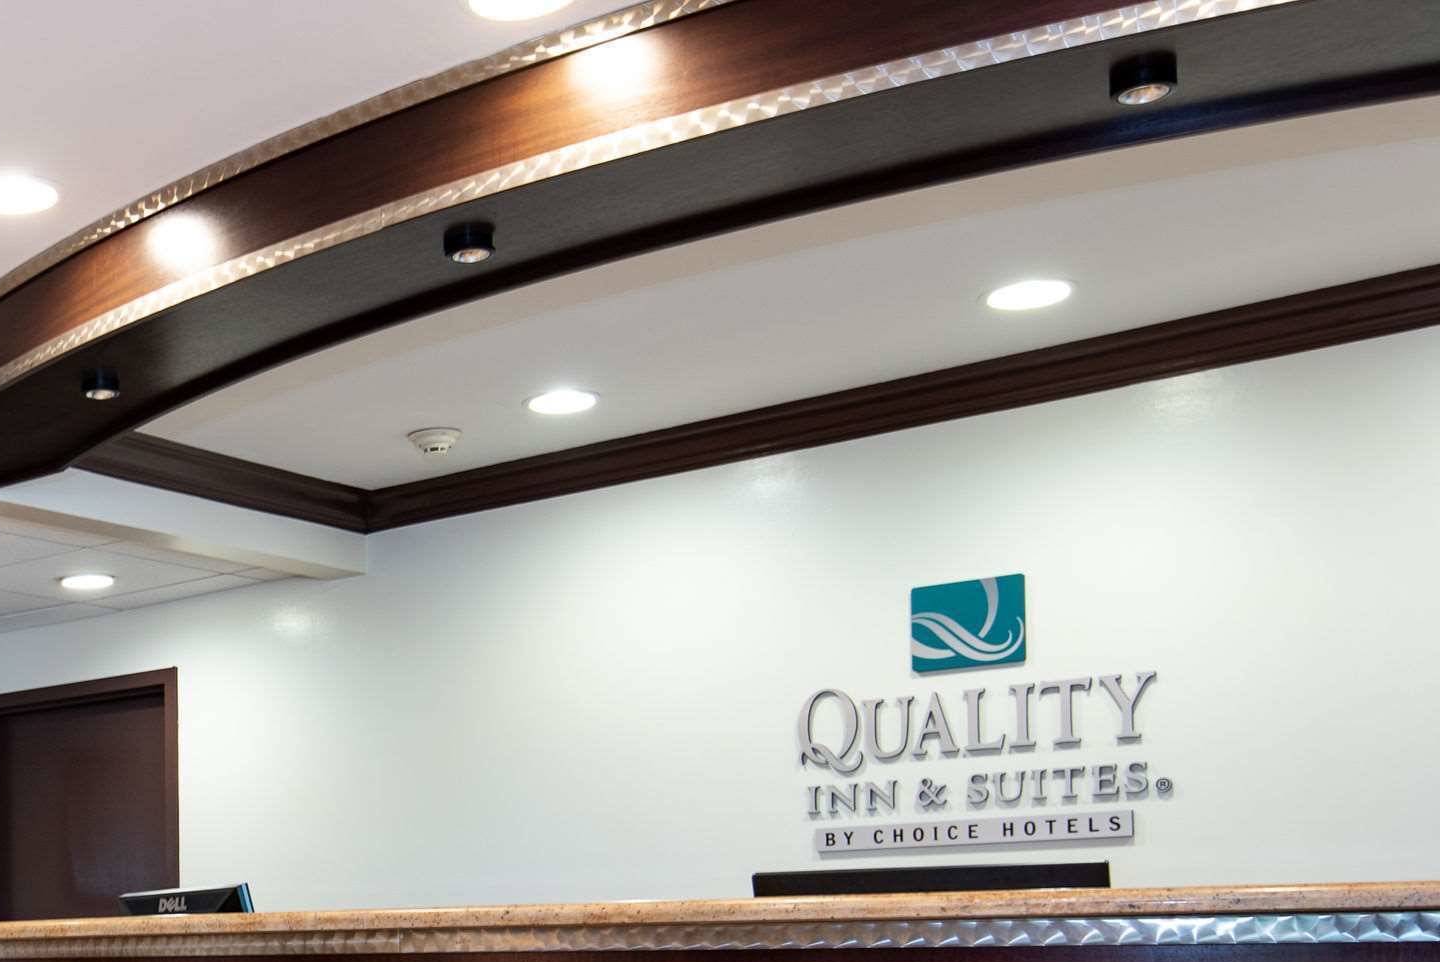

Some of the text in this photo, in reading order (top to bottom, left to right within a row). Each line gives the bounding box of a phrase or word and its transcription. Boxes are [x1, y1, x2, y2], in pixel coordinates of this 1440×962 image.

[798, 671, 1157, 775] QUALITY
[806, 779, 898, 816] INN
[918, 777, 947, 807] &
[824, 816, 1123, 847] BY CHOICE HOTELS
[158, 896, 187, 913] DELL
